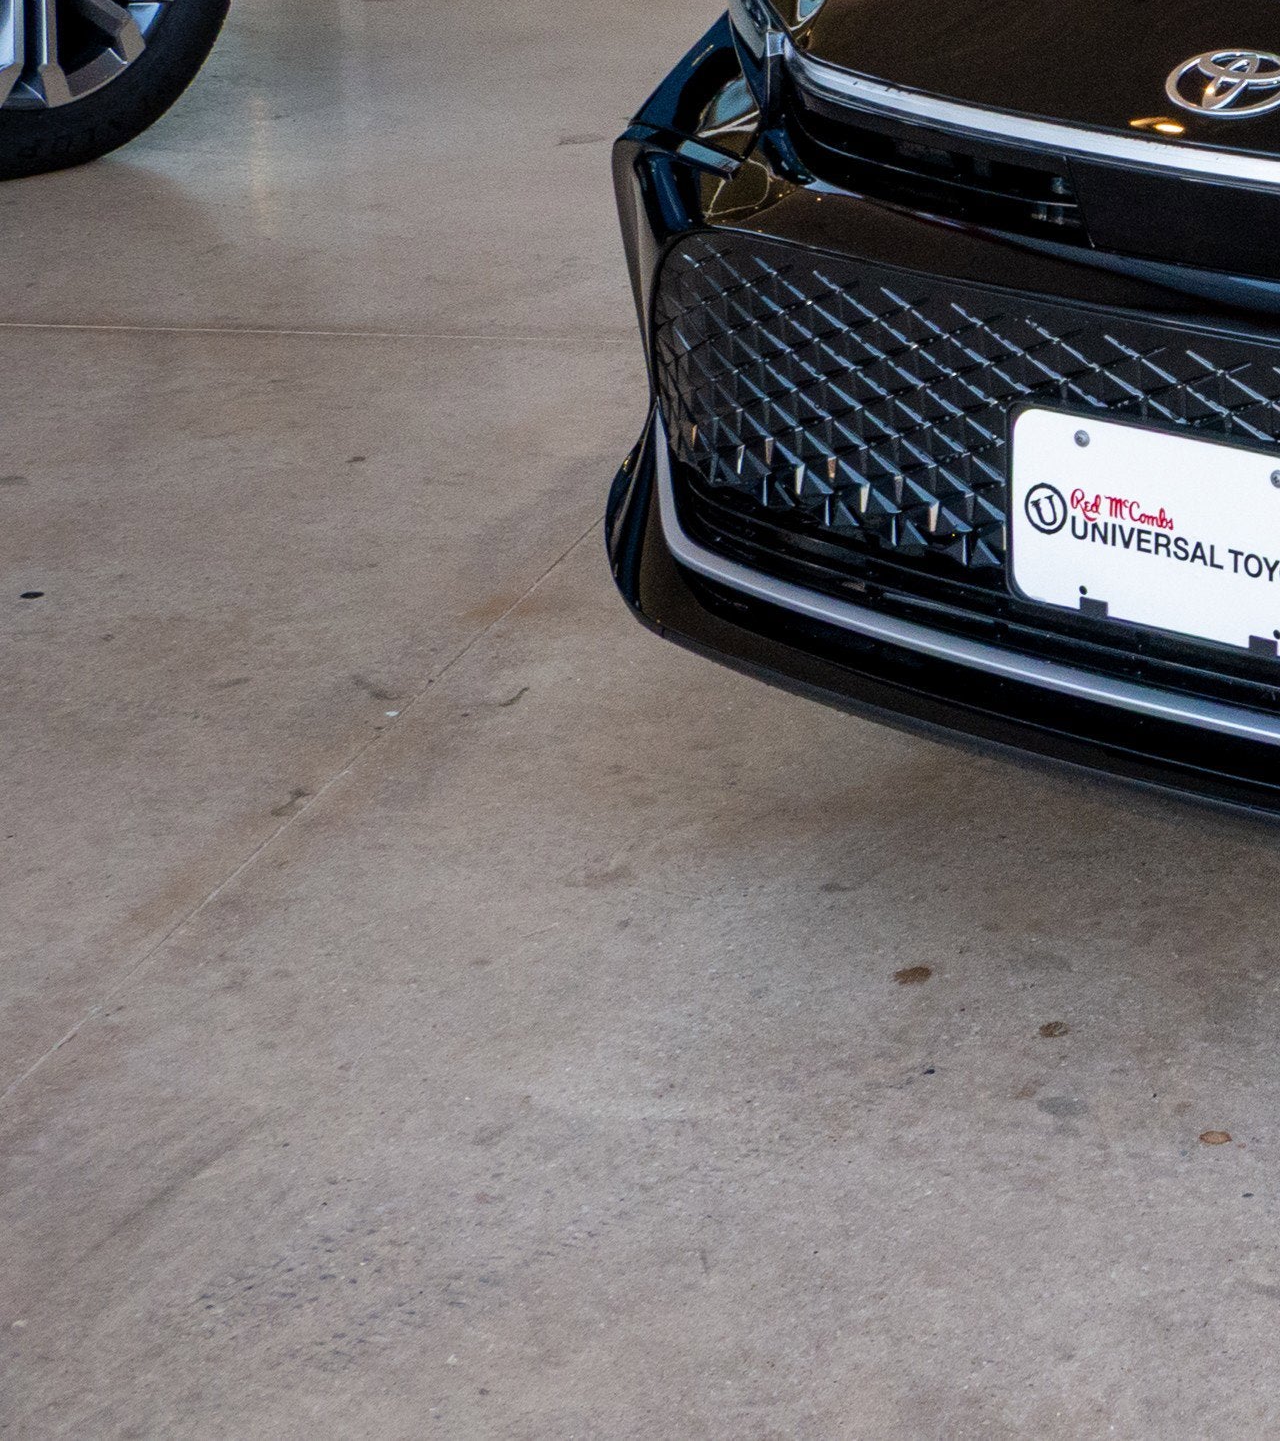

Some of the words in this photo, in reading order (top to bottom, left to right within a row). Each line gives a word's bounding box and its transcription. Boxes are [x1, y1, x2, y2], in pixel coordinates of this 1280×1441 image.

[1070, 488, 1102, 522] Red
[1103, 494, 1174, 530] McCombs
[1071, 515, 1224, 570] UNIVERSAL
